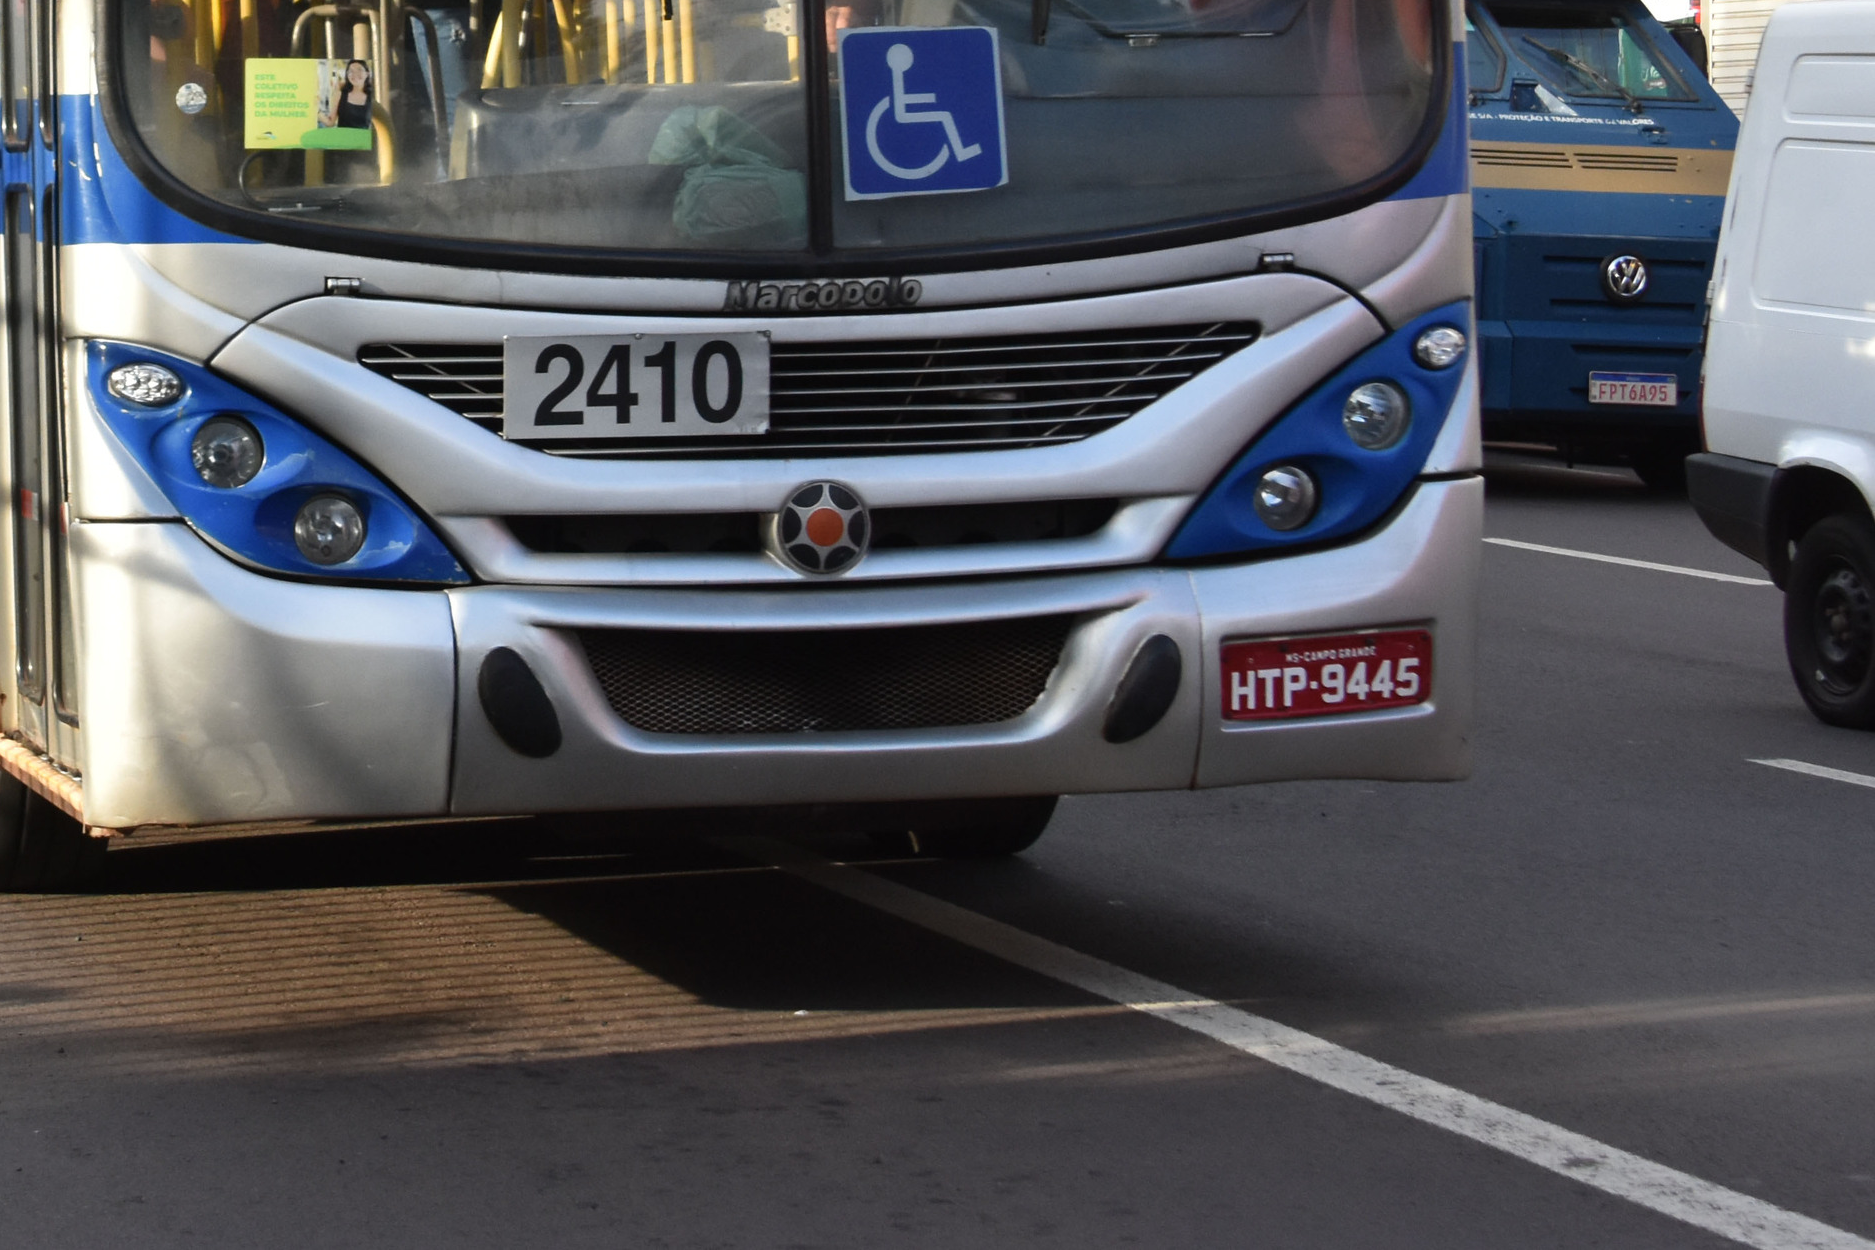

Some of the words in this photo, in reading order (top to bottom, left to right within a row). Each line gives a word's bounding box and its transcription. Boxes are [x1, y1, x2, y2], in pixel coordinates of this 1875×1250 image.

[722, 275, 923, 312] Marcopolo
[533, 340, 744, 427] 2410
[1598, 382, 1668, 402] FPT6A95
[1338, 645, 1377, 659] GRANDE
